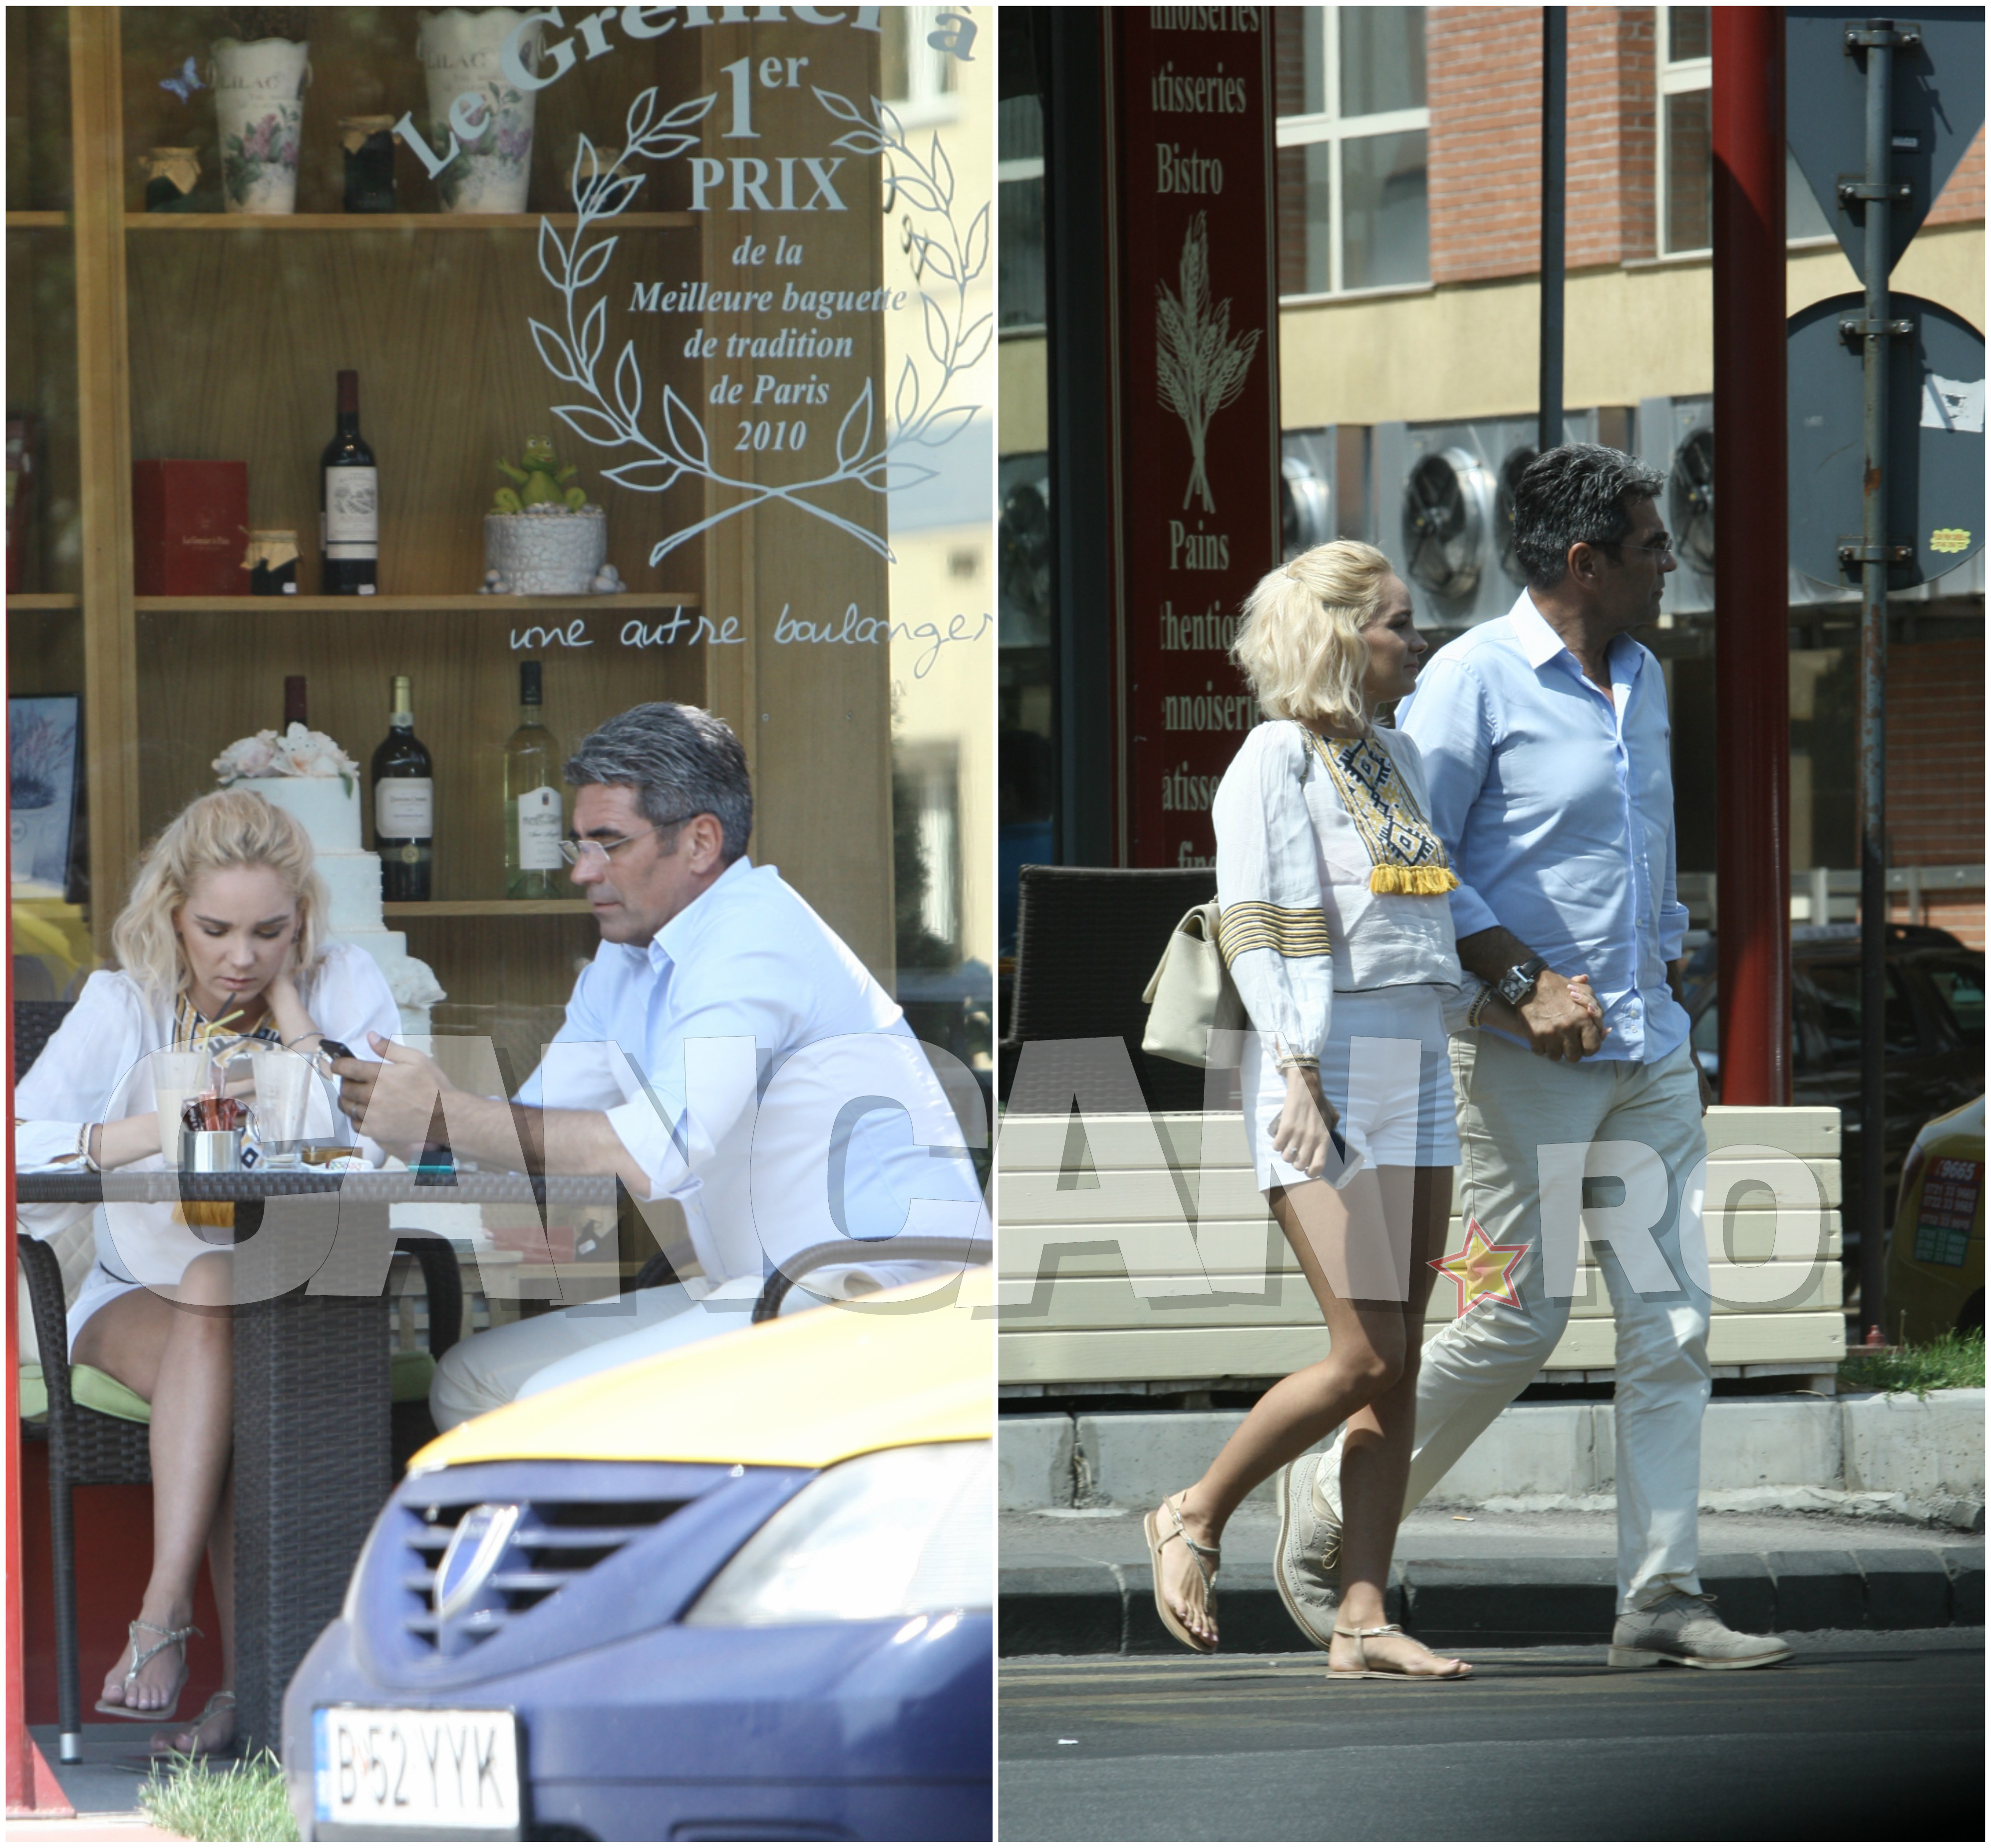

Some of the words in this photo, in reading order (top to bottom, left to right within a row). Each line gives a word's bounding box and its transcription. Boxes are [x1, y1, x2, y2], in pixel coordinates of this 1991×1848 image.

[720, 55, 809, 138] 1er
[391, 91, 491, 180] Le
[687, 157, 848, 211] PRIX
[1156, 142, 1223, 194] Bistro
[732, 236, 766, 265] de
[775, 236, 803, 265] la
[628, 282, 773, 313] Meilleure
[782, 282, 908, 319] baguette
[683, 329, 718, 358] de
[726, 329, 853, 358] tradition
[709, 375, 744, 405] de
[751, 375, 830, 405] Paris
[734, 421, 807, 451] 2010
[1169, 520, 1230, 571] Pains
[510, 619, 594, 650] une
[620, 605, 747, 647] autre
[338, 1723, 356, 1806] B
[369, 1723, 410, 1806] 52
[419, 1723, 504, 1809] YYK
